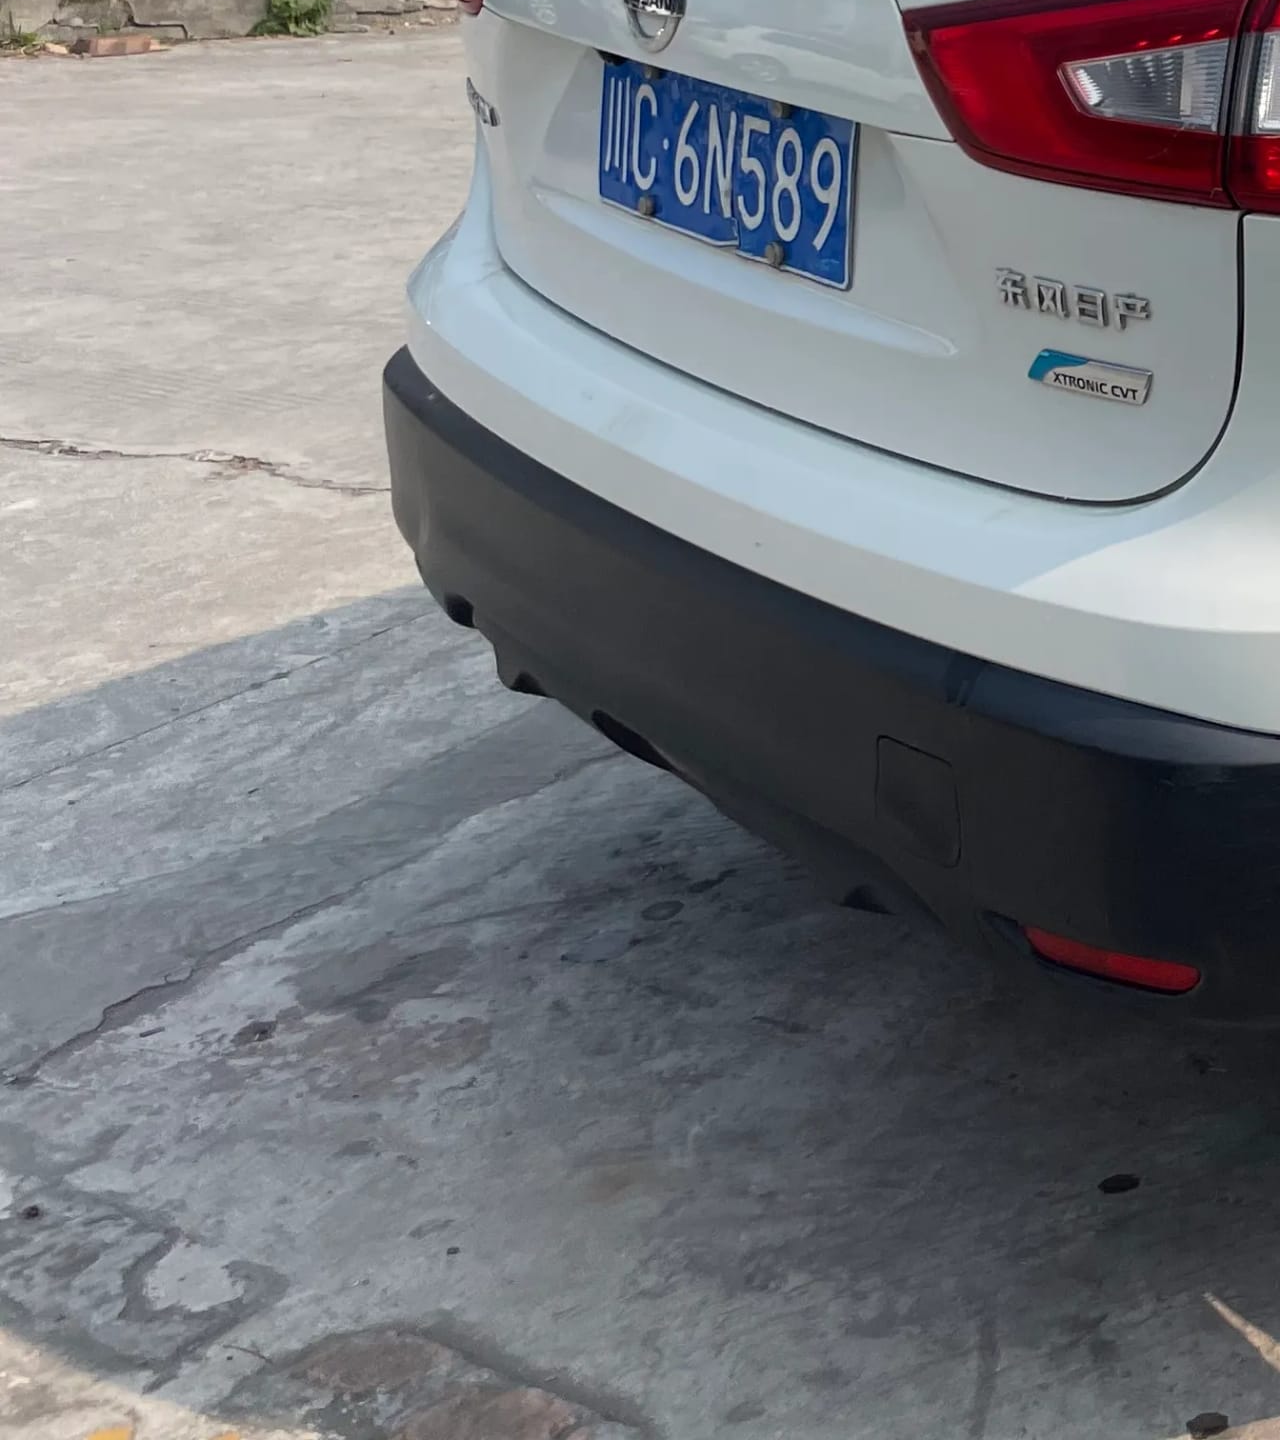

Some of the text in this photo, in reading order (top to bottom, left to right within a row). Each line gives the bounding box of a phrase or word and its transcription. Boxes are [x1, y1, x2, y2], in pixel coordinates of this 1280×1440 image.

[995, 267, 1152, 331] 东风日产
[1053, 371, 1138, 401] XTRONIC CVT
